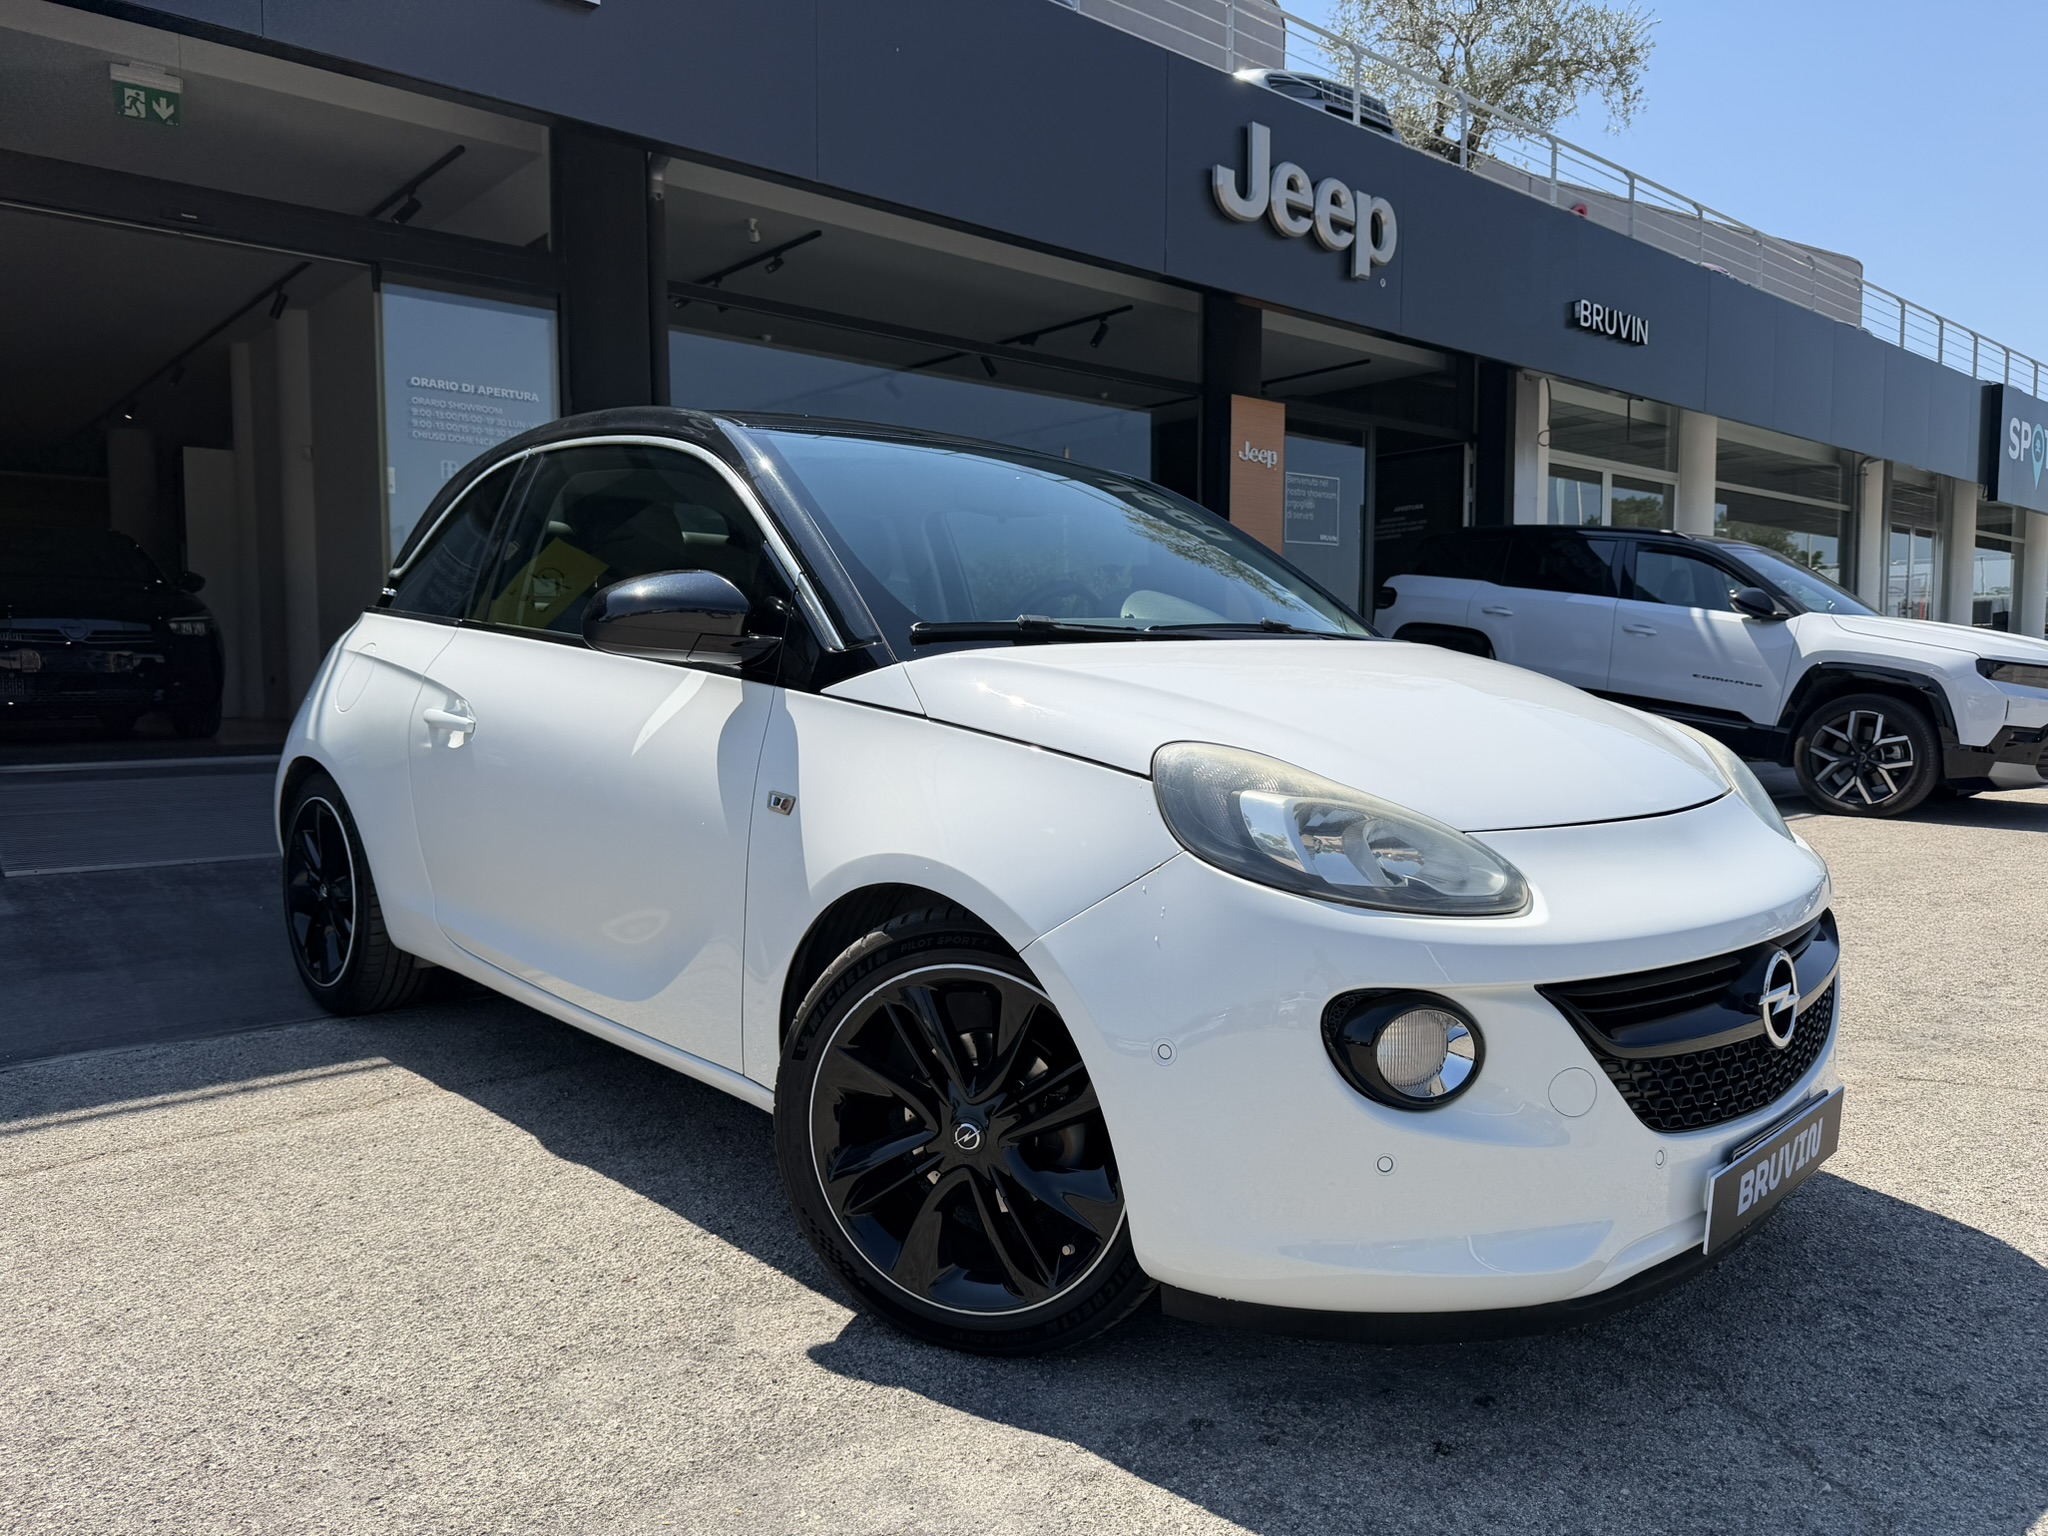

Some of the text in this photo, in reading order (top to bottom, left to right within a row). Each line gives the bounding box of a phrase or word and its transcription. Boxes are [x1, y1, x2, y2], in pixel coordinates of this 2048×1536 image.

[1212, 120, 1398, 280] Jeep
[1579, 298, 1649, 345] BRUVIN
[410, 375, 540, 402] ORARIO DI APERTURA
[411, 396, 503, 415] ORARIO SHOWROOM
[411, 430, 447, 442] CHIUSO
[1238, 441, 1278, 468] Jeep
[806, 950, 889, 1035] MICHELIN
[900, 937, 934, 953] PILOT
[937, 936, 979, 946] SPORT
[1737, 1116, 1824, 1217] BRUVIN
[1045, 1256, 1138, 1335] MICHELIN
